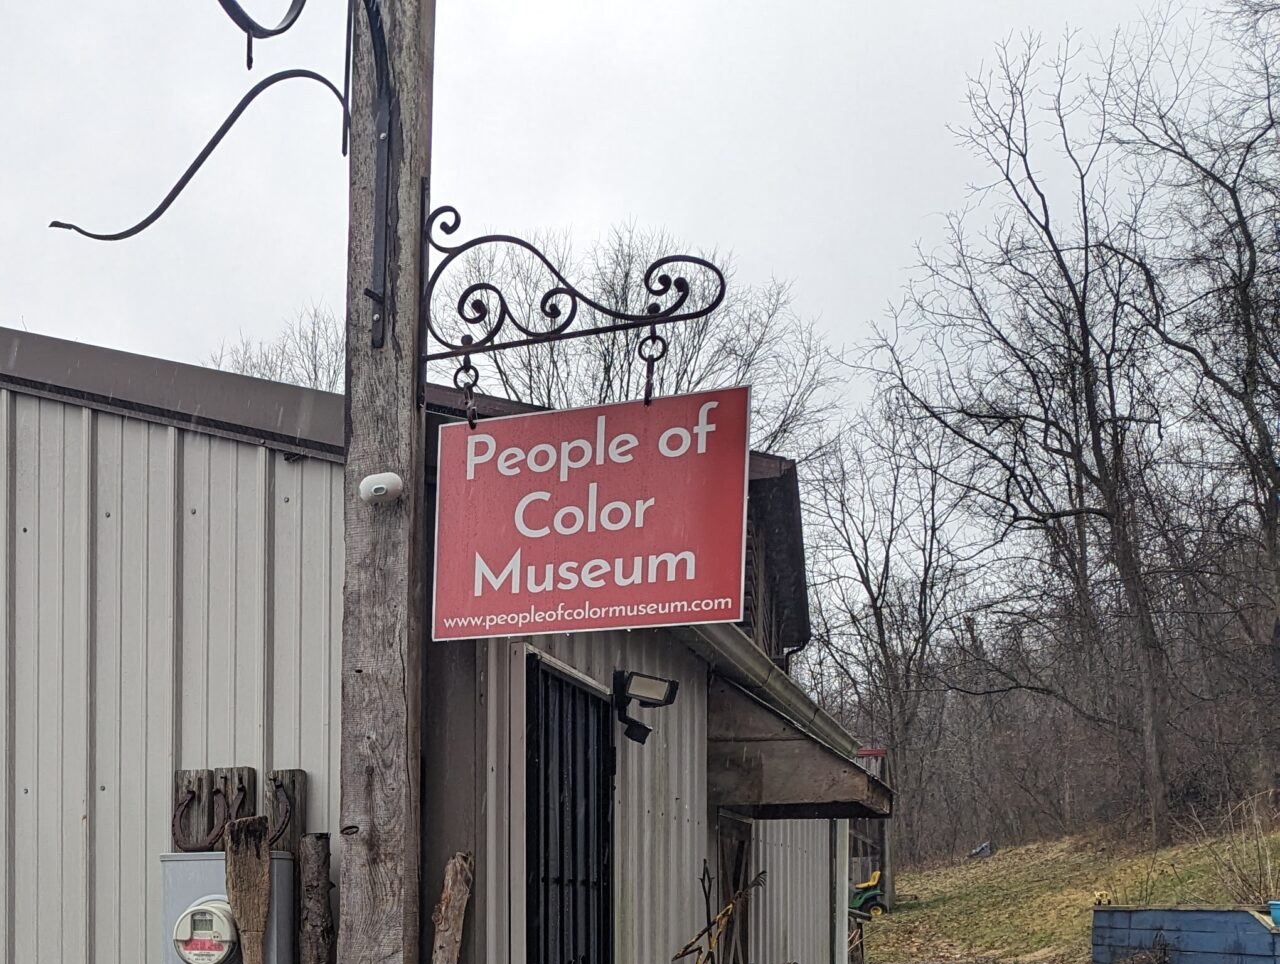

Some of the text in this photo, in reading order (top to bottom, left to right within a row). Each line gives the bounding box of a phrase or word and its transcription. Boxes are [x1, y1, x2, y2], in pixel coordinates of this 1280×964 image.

[465, 401, 719, 482] People of
[514, 482, 655, 538] Color
[474, 547, 696, 597] Museum
[443, 597, 732, 630] www.peopleofcolormuseum.com
